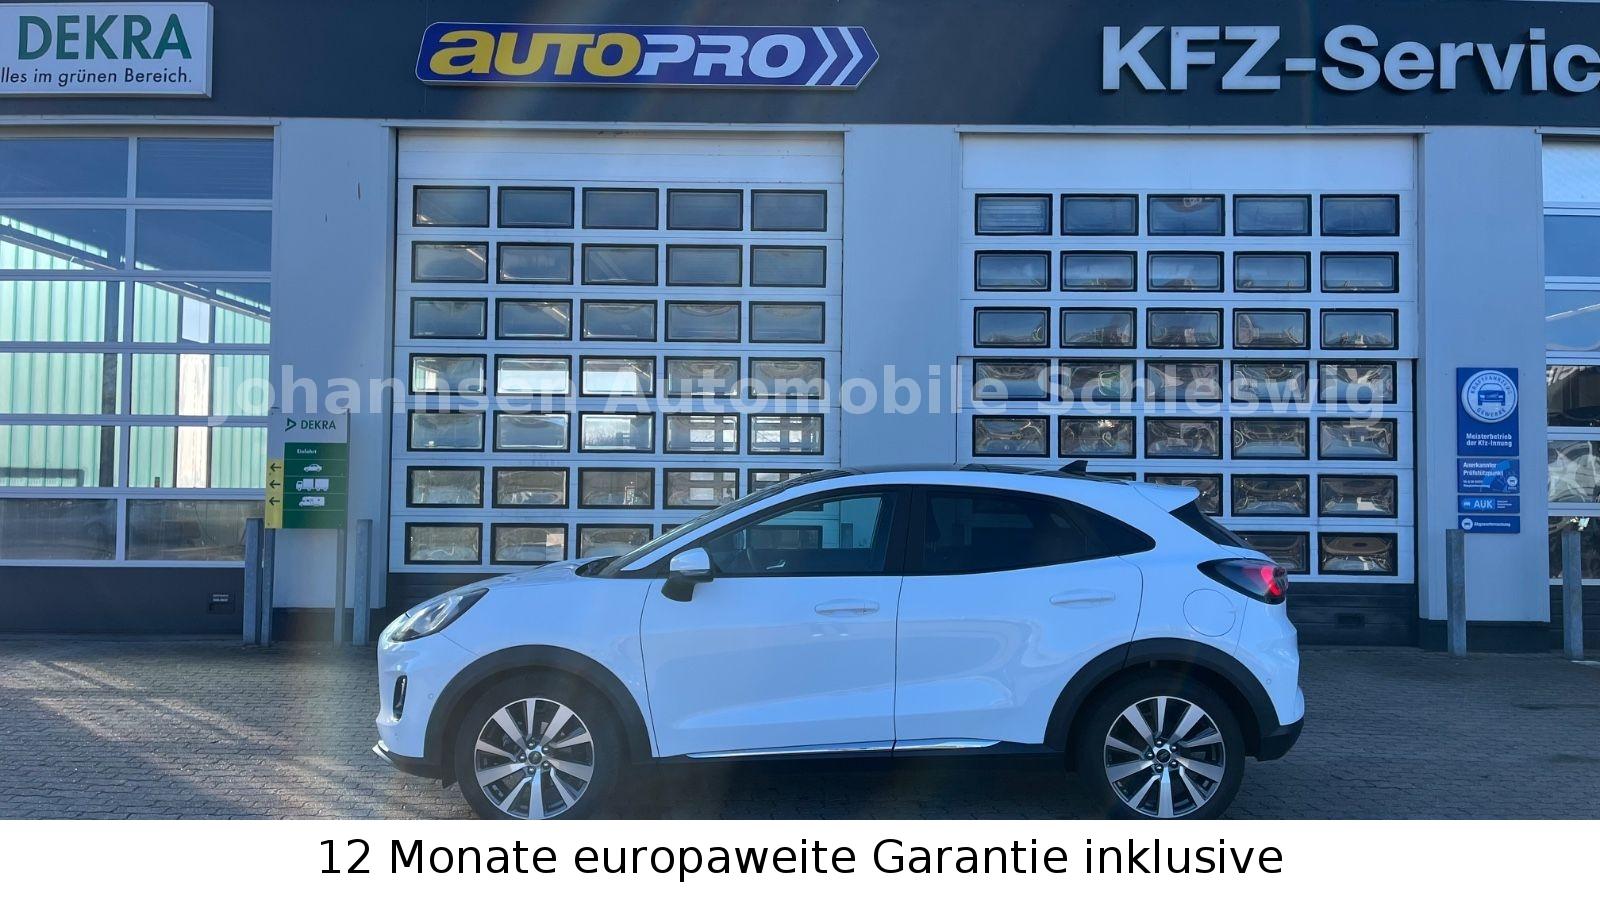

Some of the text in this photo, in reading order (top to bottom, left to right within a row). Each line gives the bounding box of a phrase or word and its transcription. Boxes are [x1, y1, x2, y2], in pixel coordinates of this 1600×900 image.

[18, 13, 192, 60] DEKRA
[0, 66, 192, 87] lles im grünen Bereich.
[301, 419, 337, 430] DEKRA
[1465, 432, 1513, 440] Meisterbetrieb
[1473, 499, 1493, 509] AUK
